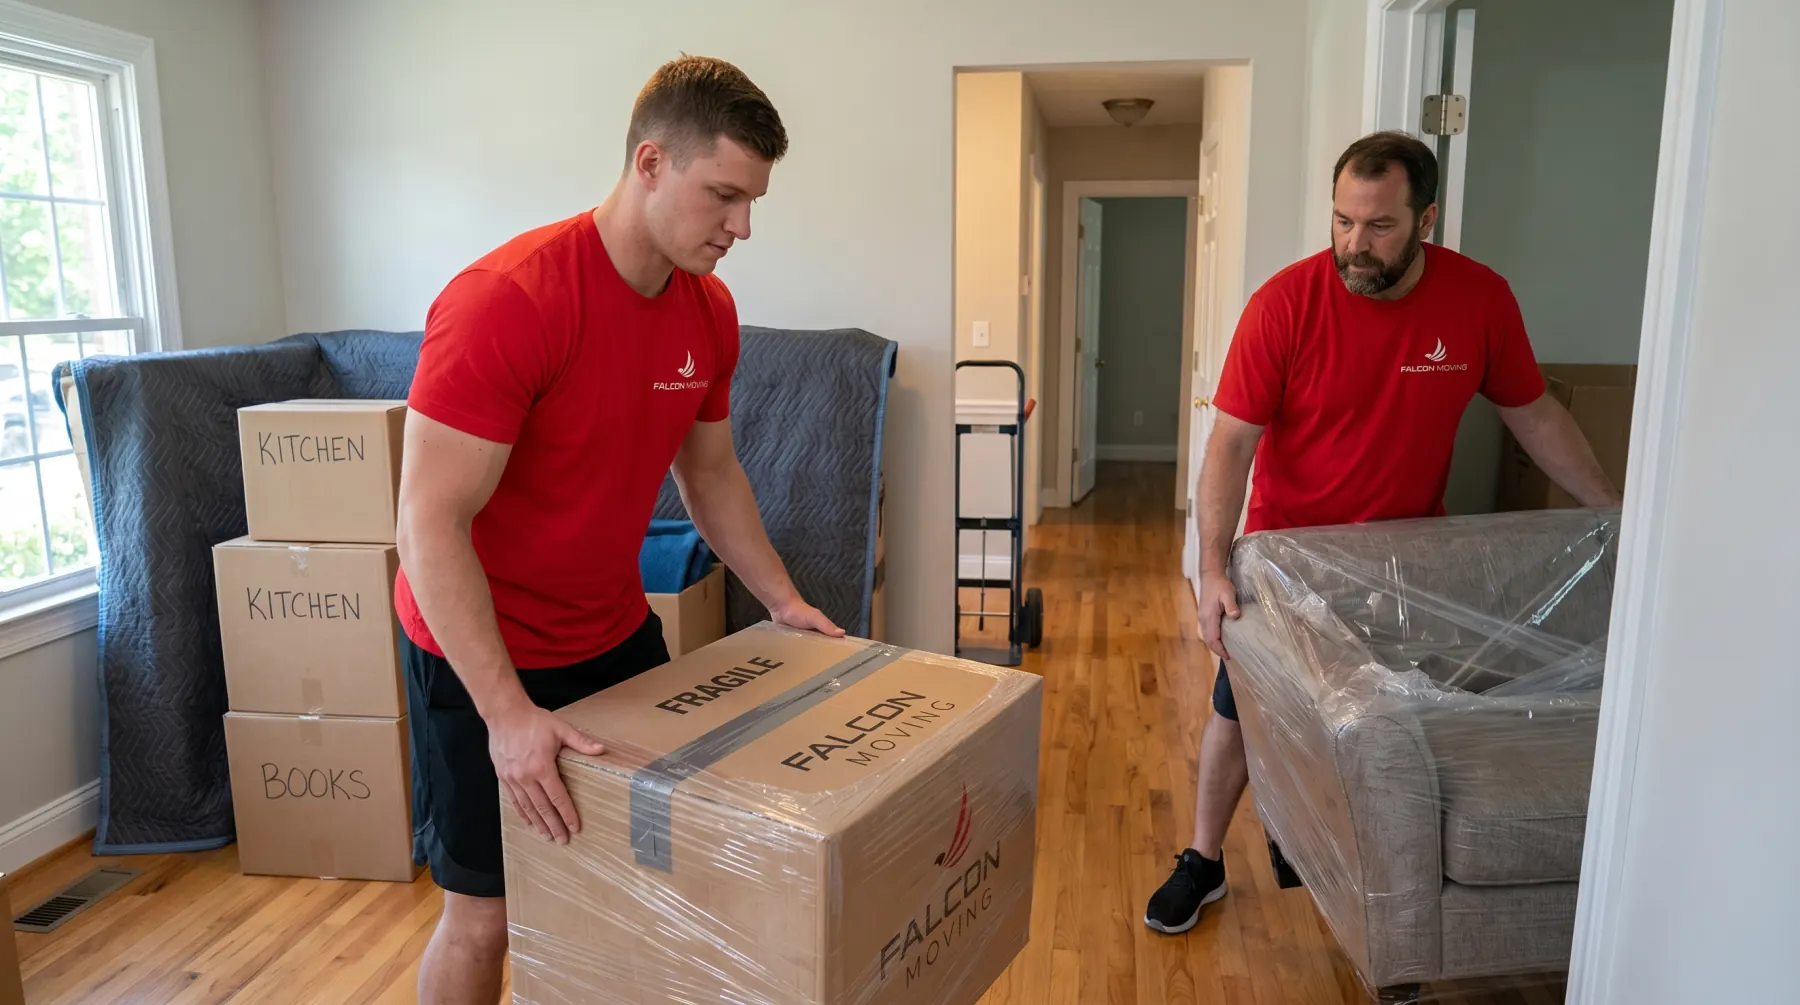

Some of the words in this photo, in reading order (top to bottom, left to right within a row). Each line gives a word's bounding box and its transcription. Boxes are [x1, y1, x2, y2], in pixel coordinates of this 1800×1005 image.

[653, 382, 685, 390] FALCON
[258, 431, 365, 465] KITCHEN
[246, 587, 361, 621] KITCHEN
[655, 656, 784, 715] FRAGILE
[780, 690, 926, 772] FALCON
[845, 699, 956, 767] MOVING
[261, 762, 371, 800] BOOKS
[880, 840, 1001, 981] FALCON
[906, 887, 993, 989] MOVING
